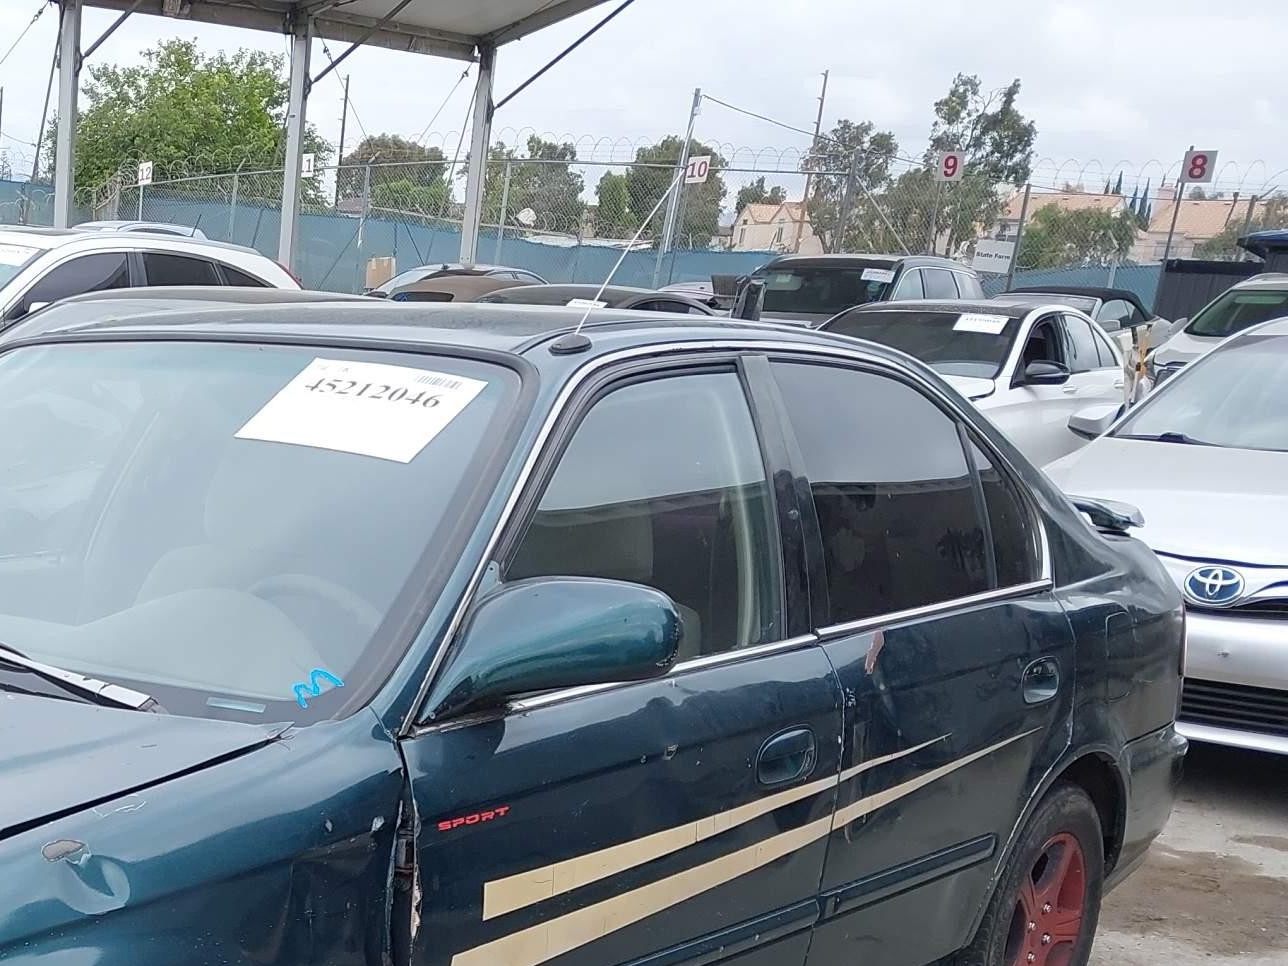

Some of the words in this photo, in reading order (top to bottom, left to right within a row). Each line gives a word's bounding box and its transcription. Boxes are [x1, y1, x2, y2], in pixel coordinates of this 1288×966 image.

[139, 166, 151, 181] 12
[687, 160, 708, 179] 10
[943, 155, 958, 178] 9
[1188, 154, 1208, 179] 8
[994, 252, 1011, 260] Farm
[305, 376, 440, 409] 45212046
[438, 806, 510, 832] SPORT
